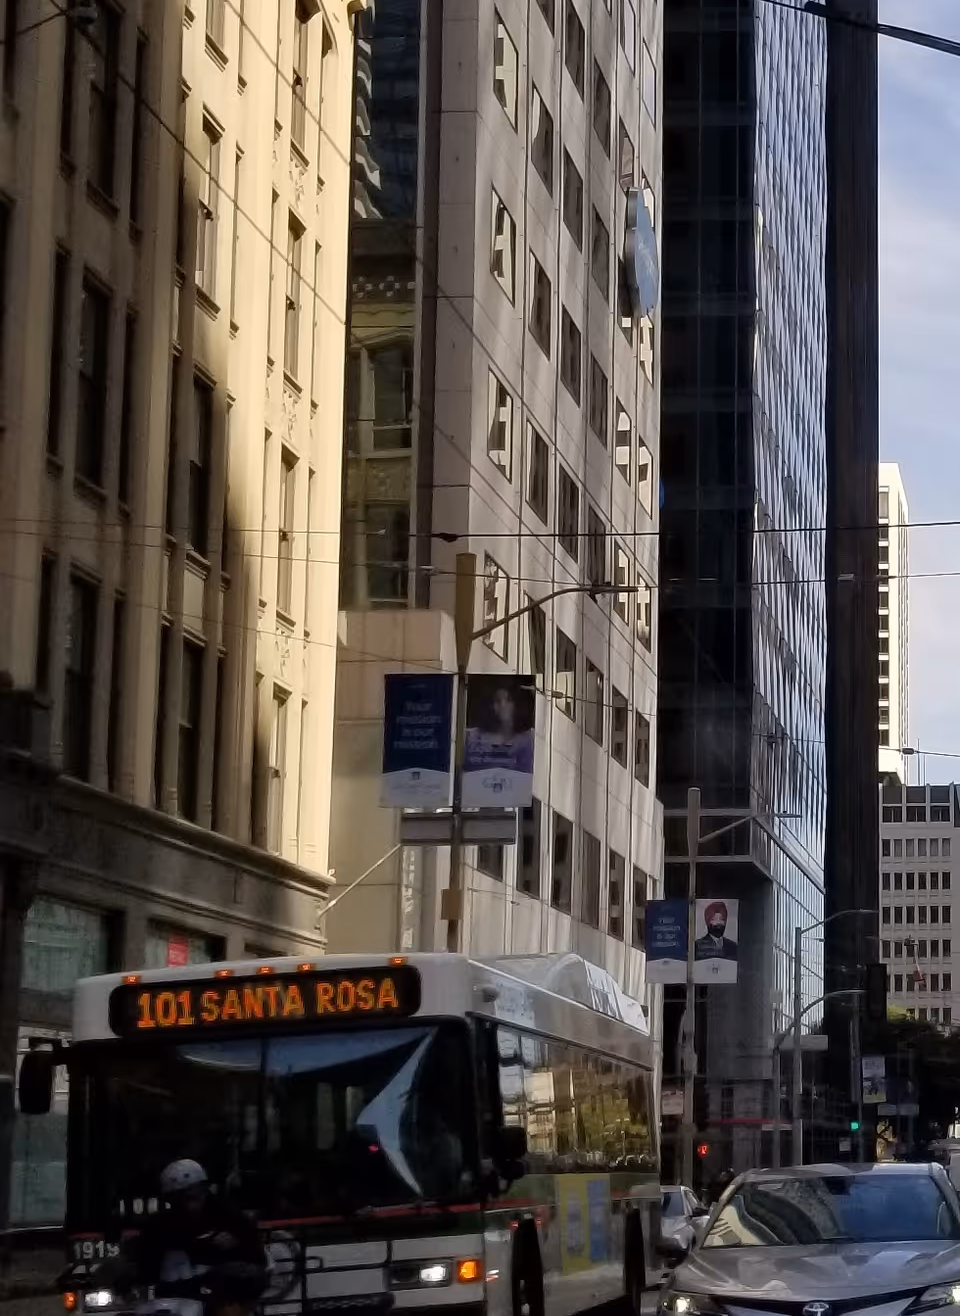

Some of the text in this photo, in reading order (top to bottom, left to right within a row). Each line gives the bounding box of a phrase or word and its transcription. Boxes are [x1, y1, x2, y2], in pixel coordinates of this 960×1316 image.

[137, 977, 399, 1028] 101 SANTA ROSA
